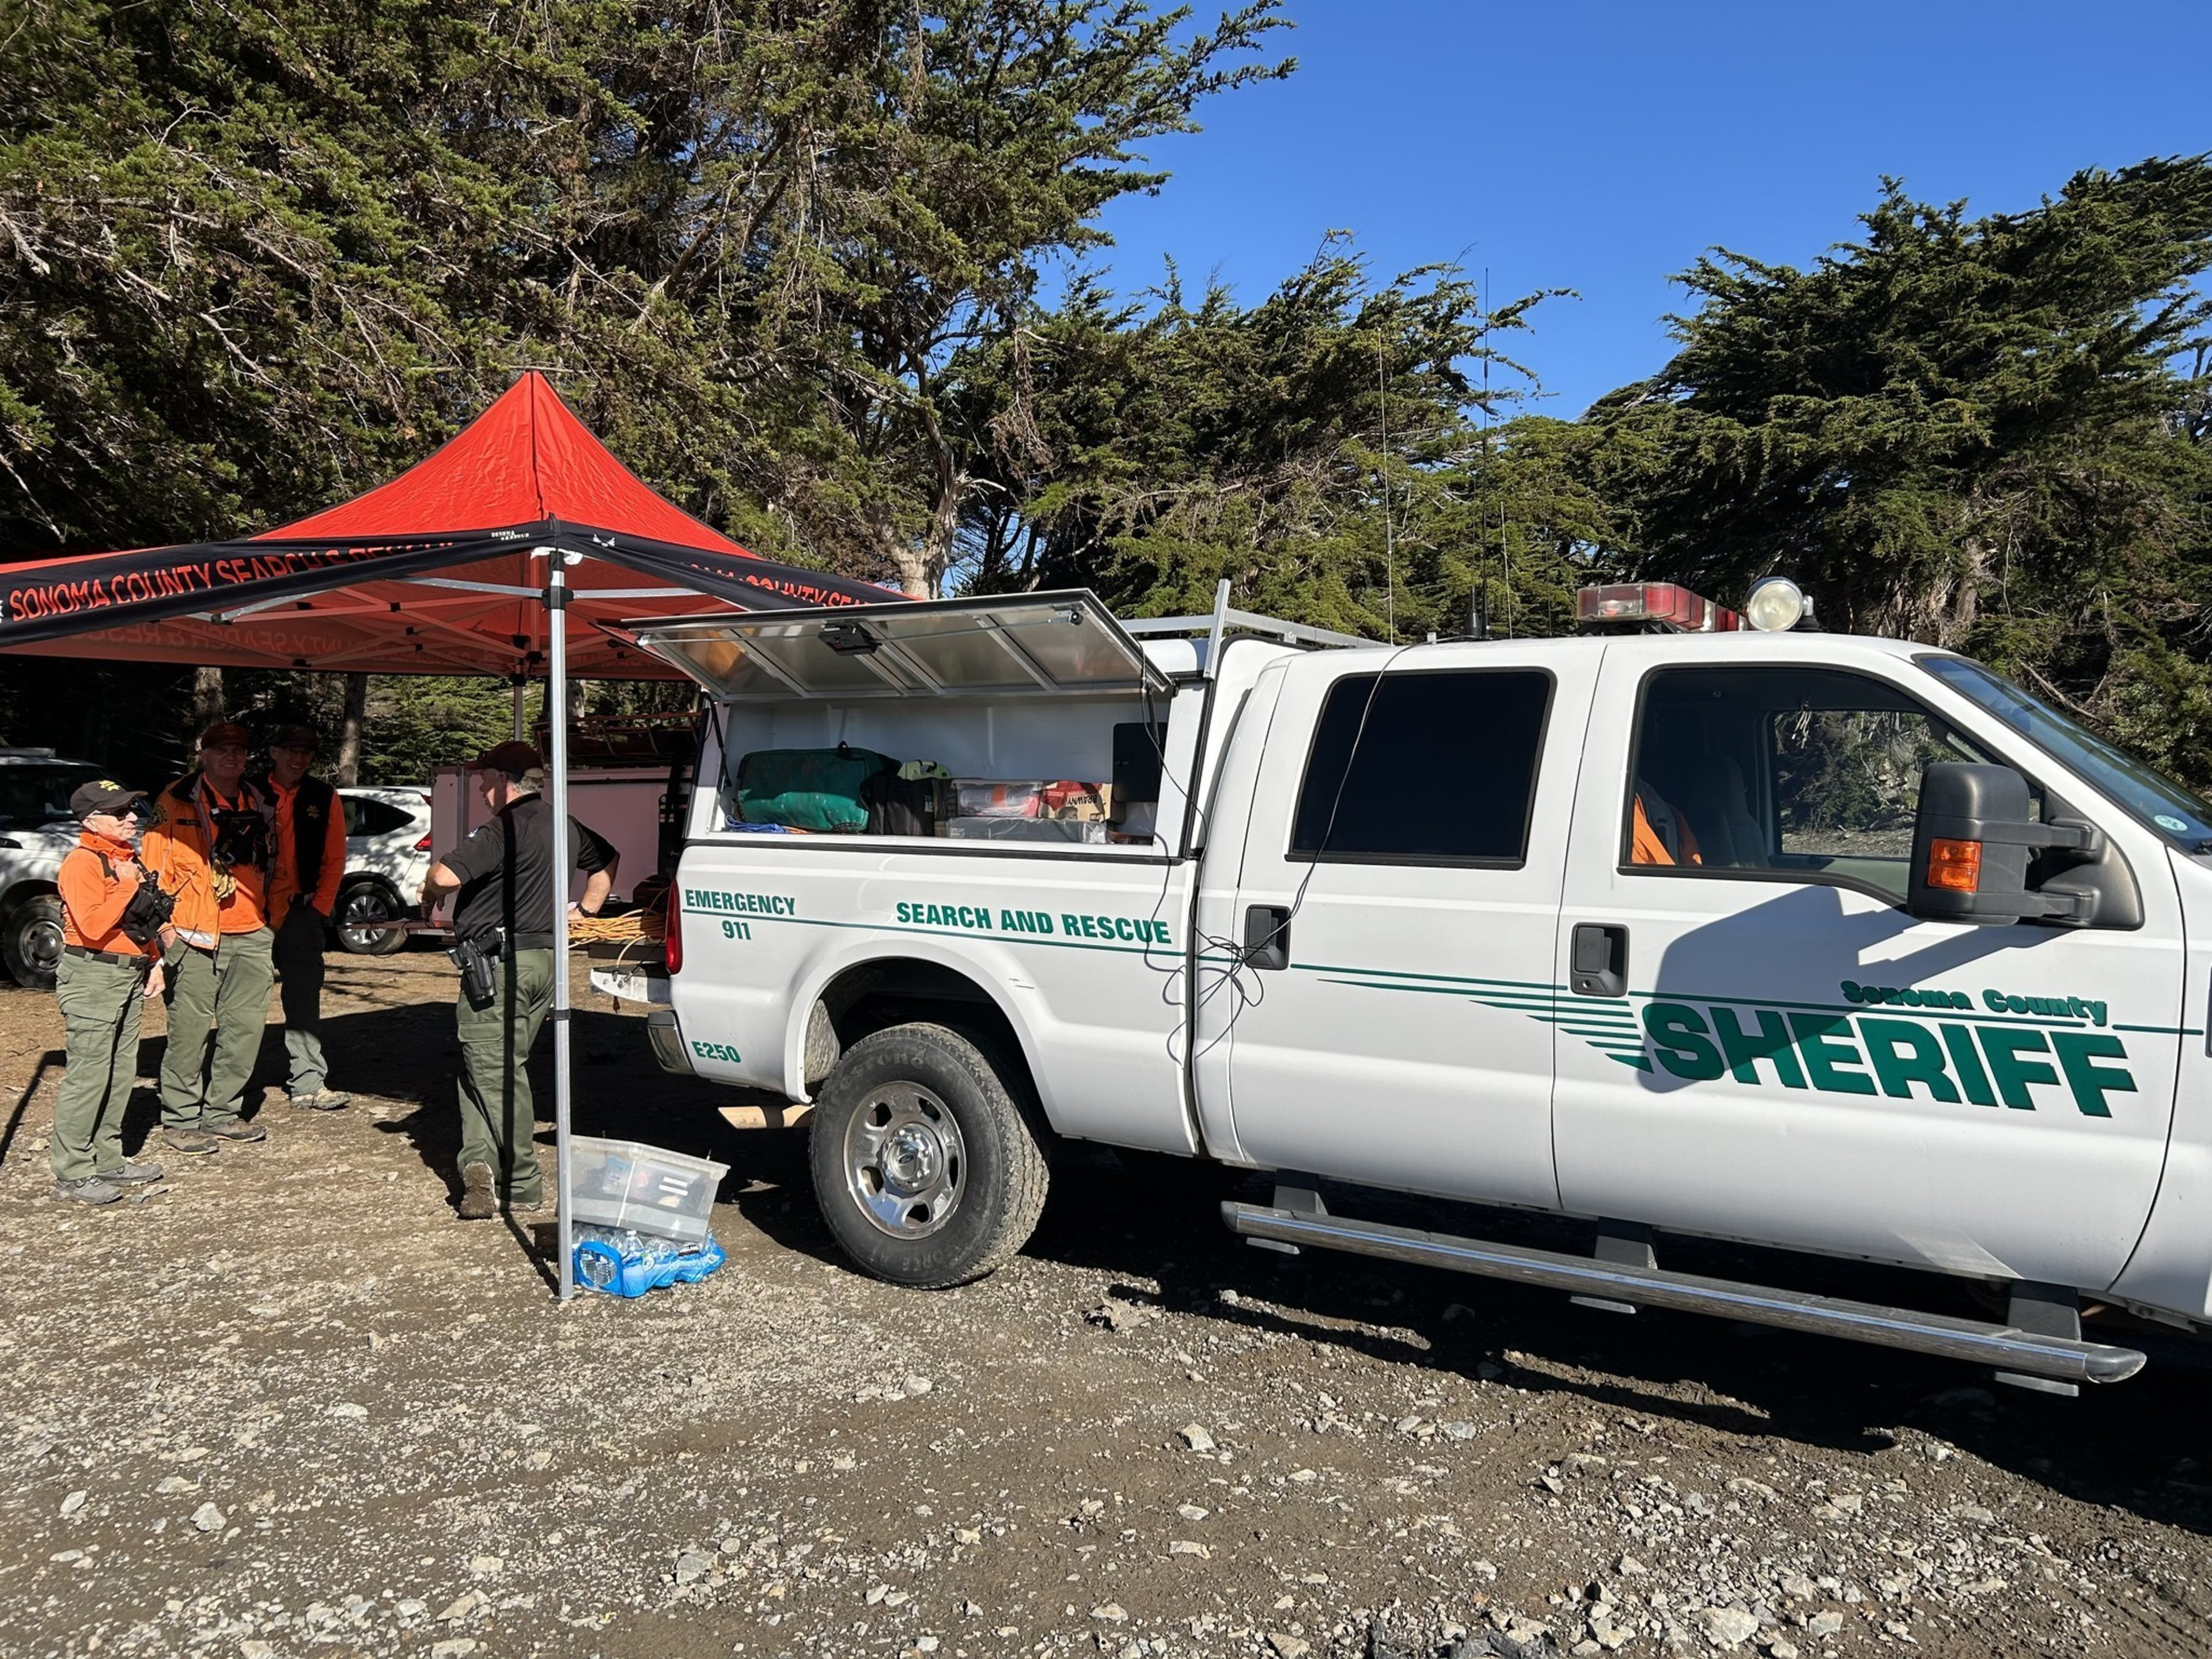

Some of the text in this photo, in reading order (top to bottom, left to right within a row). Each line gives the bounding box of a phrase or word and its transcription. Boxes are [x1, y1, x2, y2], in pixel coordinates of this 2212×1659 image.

[9, 578, 111, 622] SONOMA
[111, 563, 212, 604] COUNTY
[685, 889, 795, 915] EMERGENCY
[896, 902, 1172, 944] SEARCH AND RESCUE
[722, 920, 751, 940] 911
[1840, 980, 2107, 1026] Sonoma County
[691, 1041, 741, 1063] E250
[1642, 1002, 2138, 1118] SHERIFF
